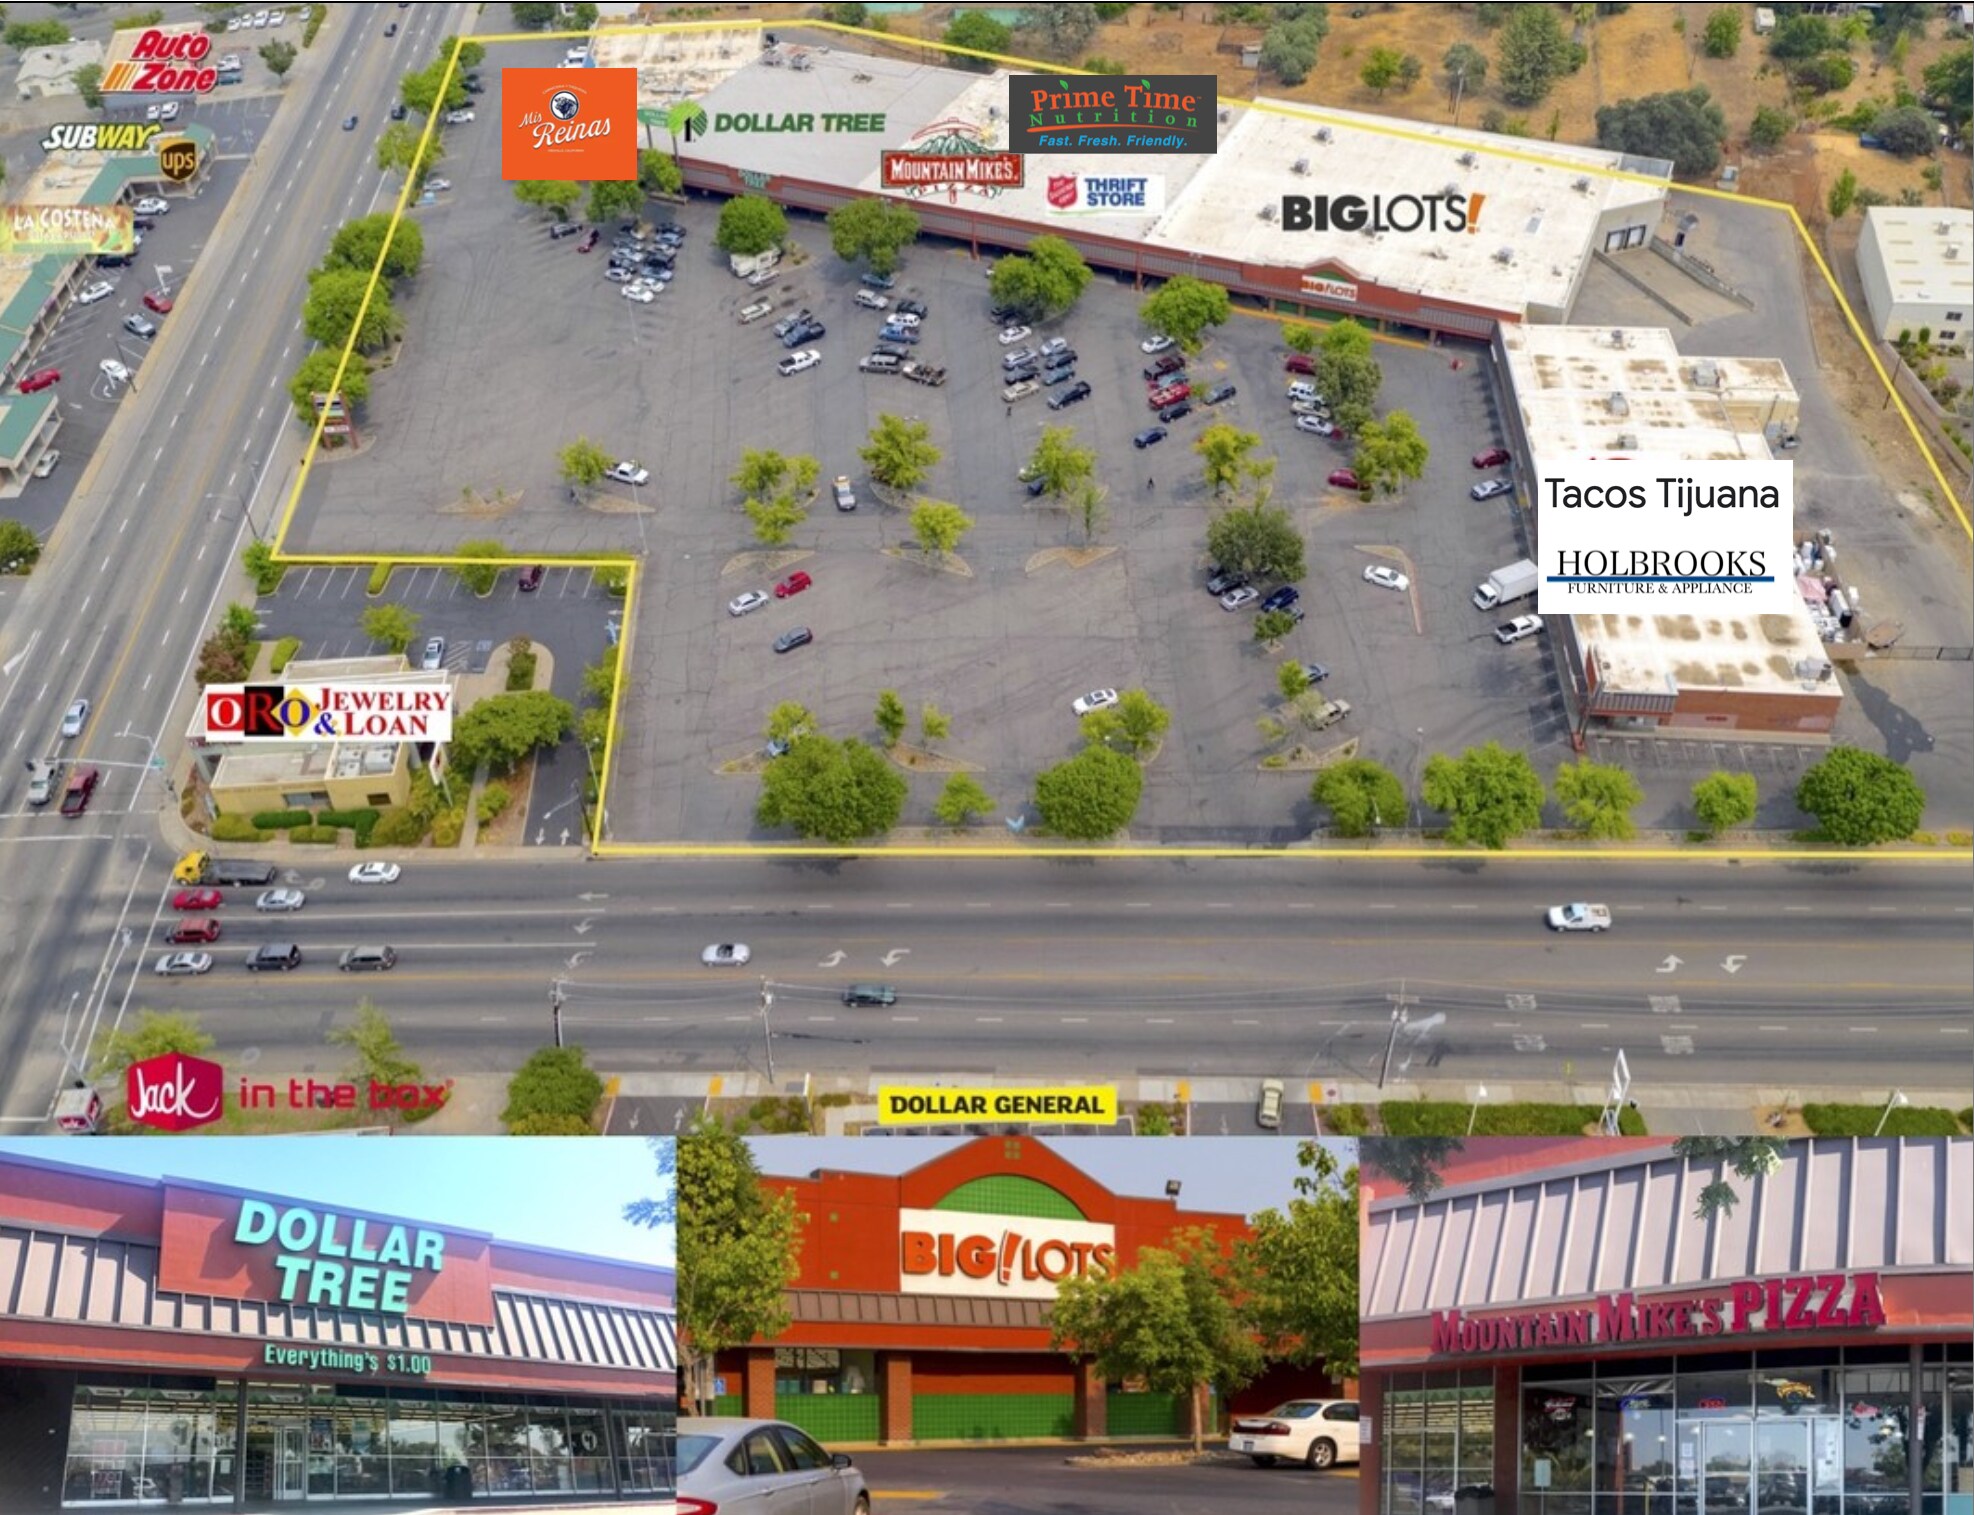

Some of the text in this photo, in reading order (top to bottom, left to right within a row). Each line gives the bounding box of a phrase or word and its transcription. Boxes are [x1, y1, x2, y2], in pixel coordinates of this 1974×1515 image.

[234, 1198, 446, 1272] DOLLAR
[275, 1254, 412, 1314] TREE
[1430, 1272, 1888, 1354] MOUNTAIN MIKE'S PIZZA
[264, 1344, 432, 1375] Everything's $1.00
